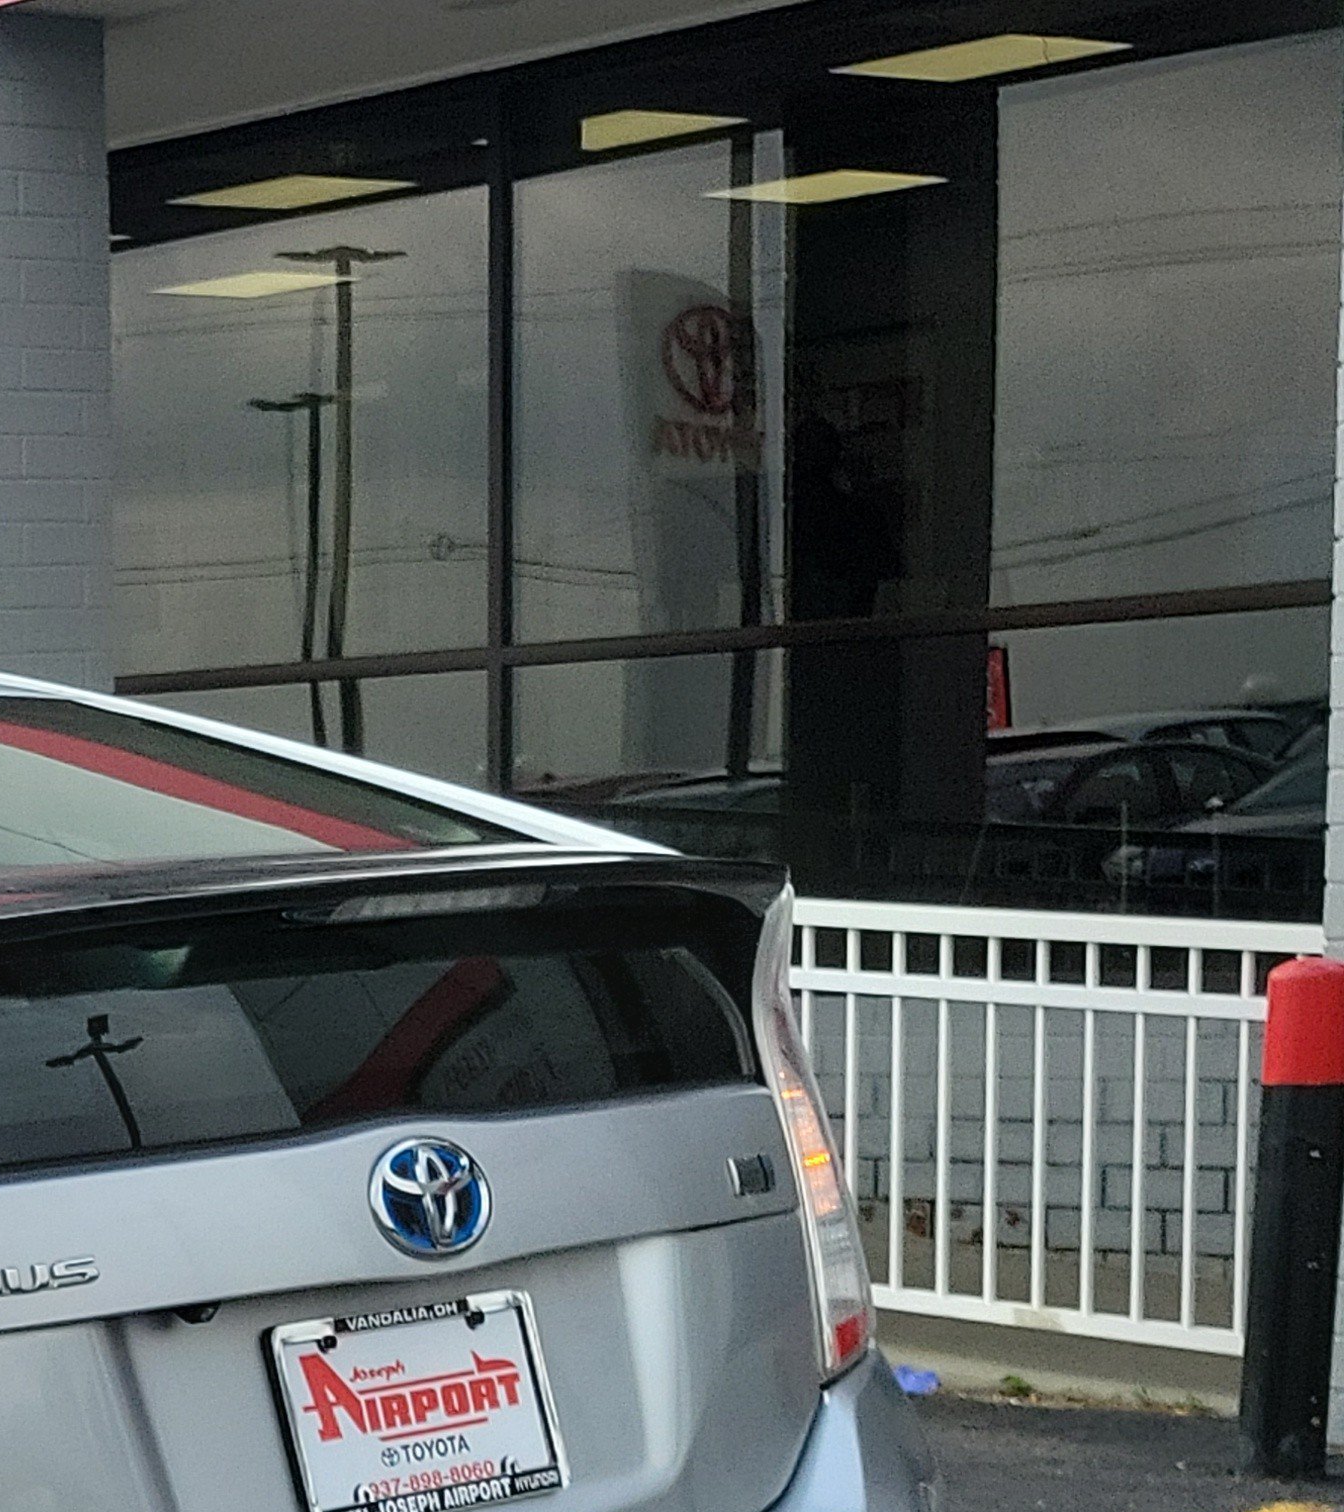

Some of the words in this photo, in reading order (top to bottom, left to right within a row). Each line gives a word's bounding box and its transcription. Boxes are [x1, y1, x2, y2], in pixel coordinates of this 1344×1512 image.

[349, 1359, 406, 1383] Joseph
[298, 1353, 520, 1442] AIRPORT
[401, 1434, 471, 1463] TOYOTA
[443, 1476, 512, 1510] AIRPORT
